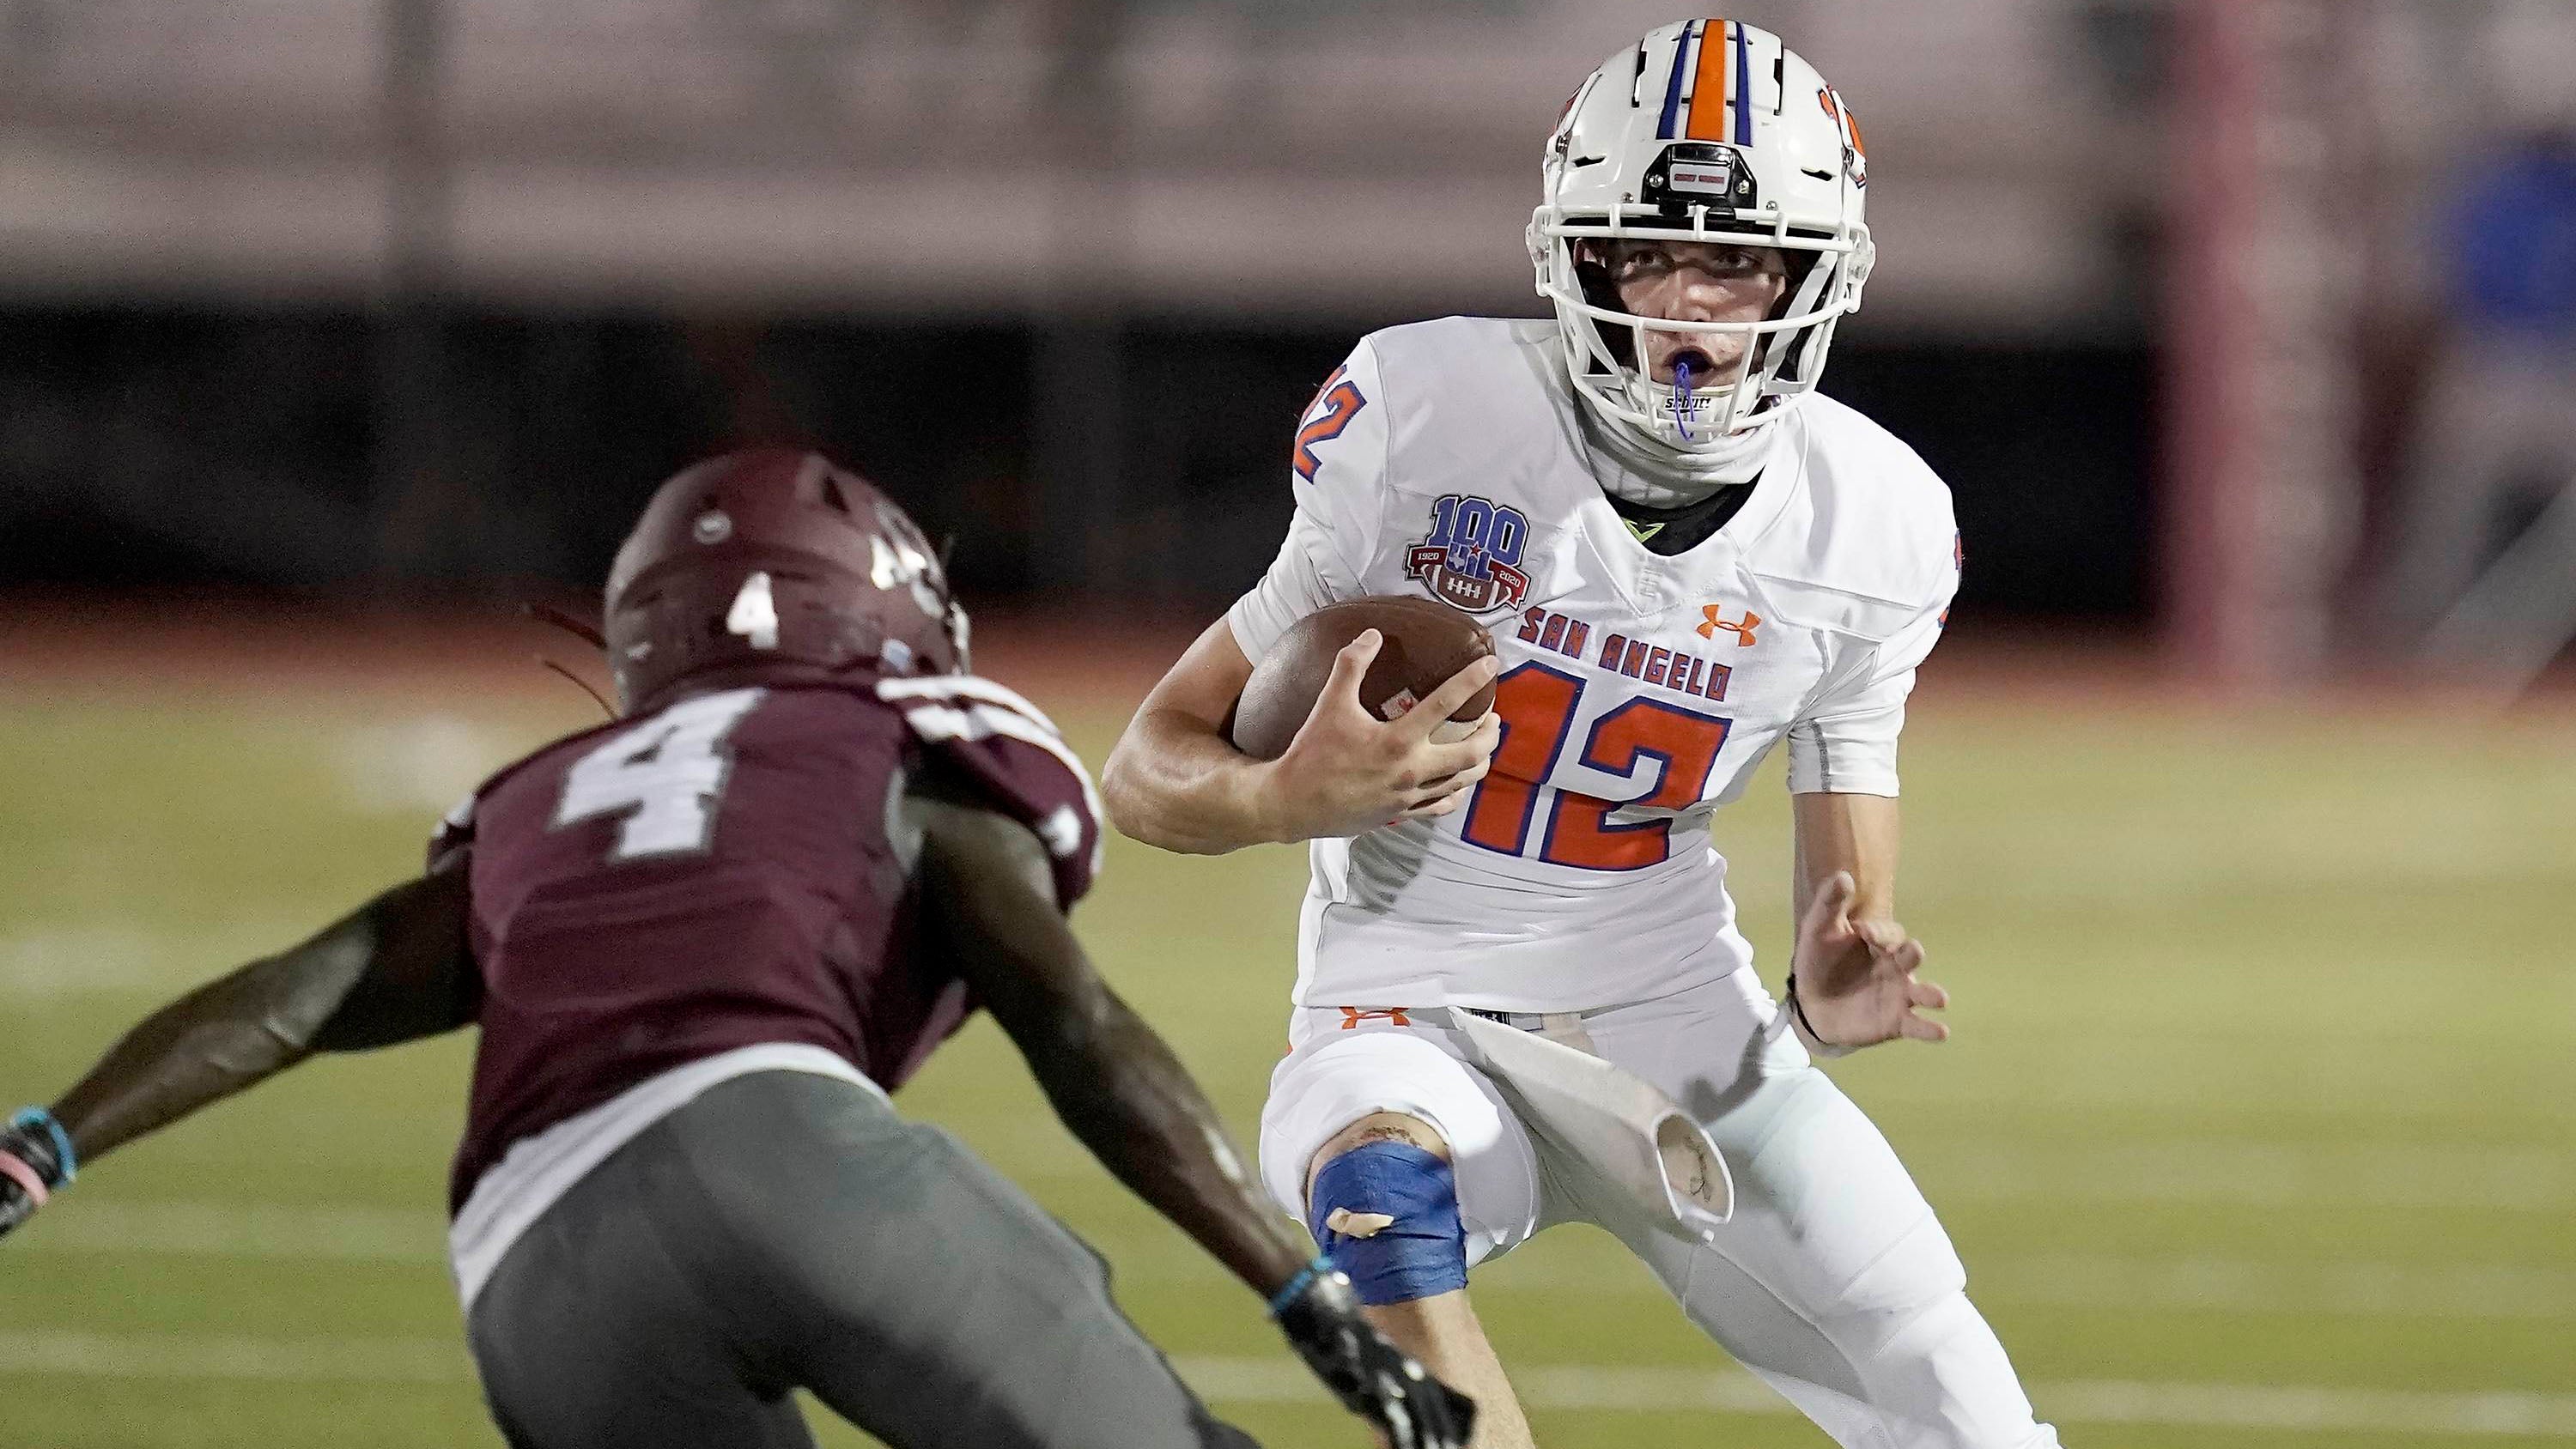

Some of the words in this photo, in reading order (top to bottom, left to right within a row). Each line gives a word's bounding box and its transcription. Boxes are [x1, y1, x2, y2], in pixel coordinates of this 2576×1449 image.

[1418, 552, 1440, 561] 1920
[1426, 495, 1529, 567] 100
[726, 571, 780, 650] 4
[1499, 570, 1522, 588] 2020
[1517, 606, 1590, 659] SAN
[1598, 634, 1733, 702] ANGELO
[544, 687, 769, 865] 4
[1460, 659, 1733, 872] 12
